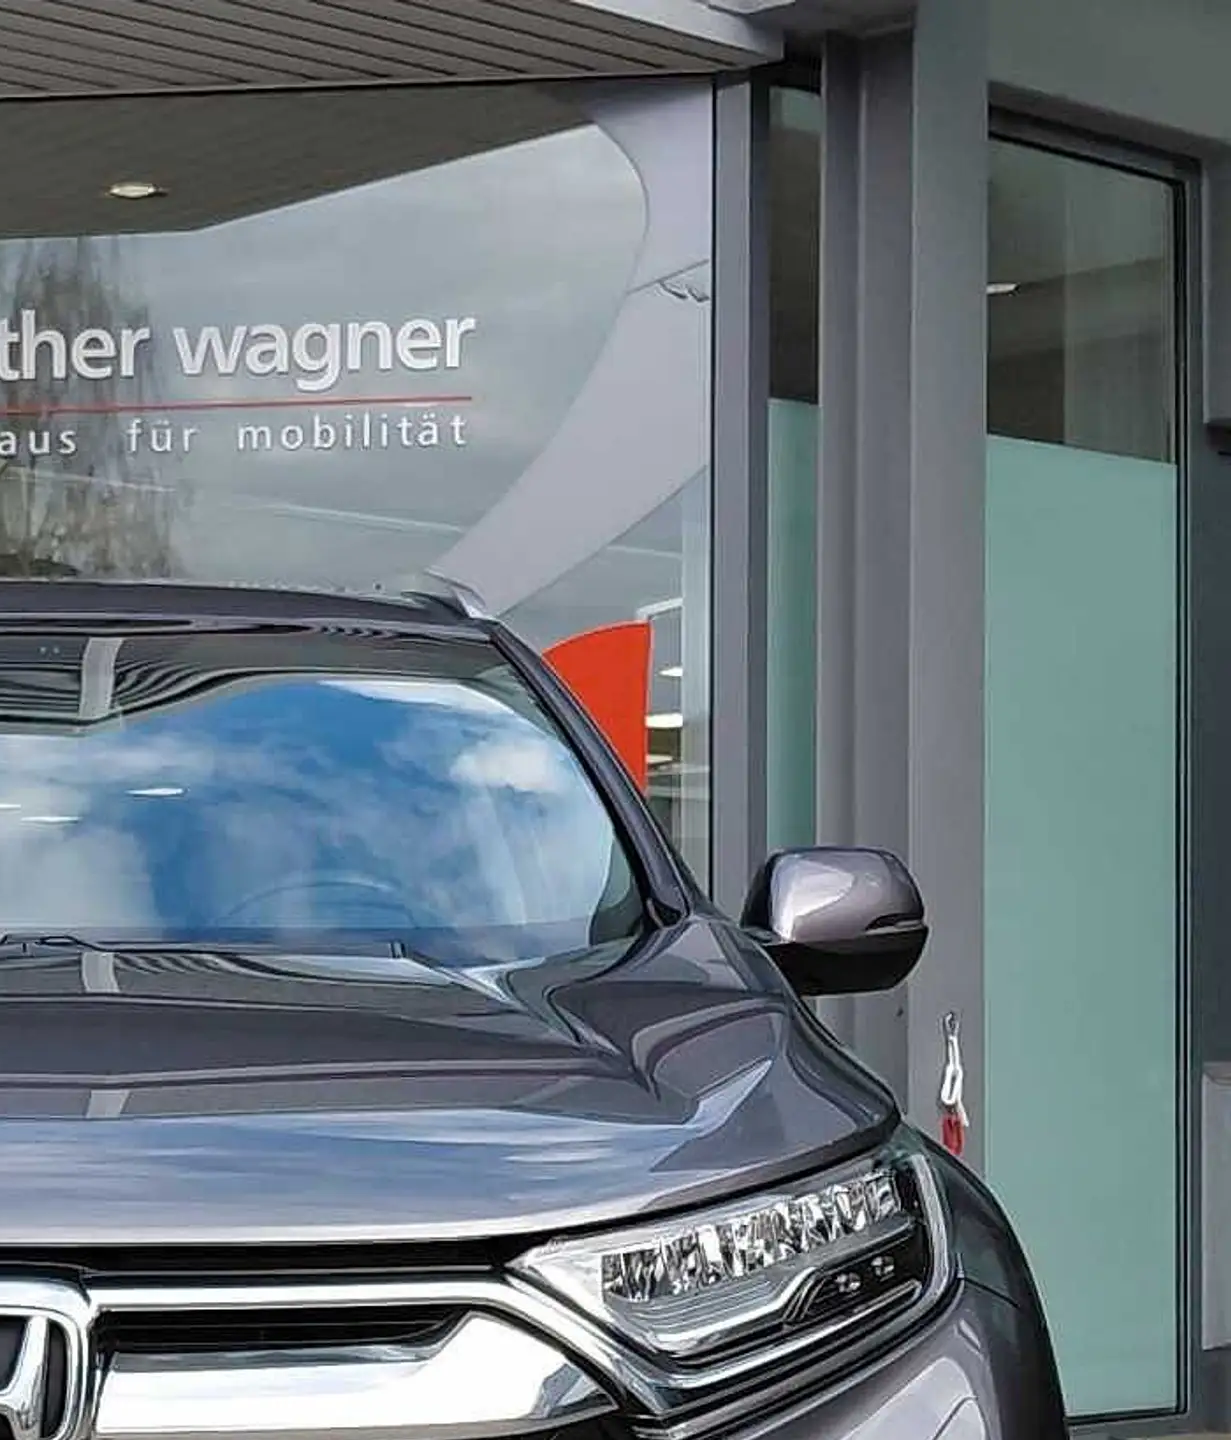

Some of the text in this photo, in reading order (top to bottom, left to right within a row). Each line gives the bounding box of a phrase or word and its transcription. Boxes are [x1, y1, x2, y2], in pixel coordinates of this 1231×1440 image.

[172, 317, 477, 392] wagner
[126, 418, 198, 453] für
[237, 413, 468, 451] mobilität
